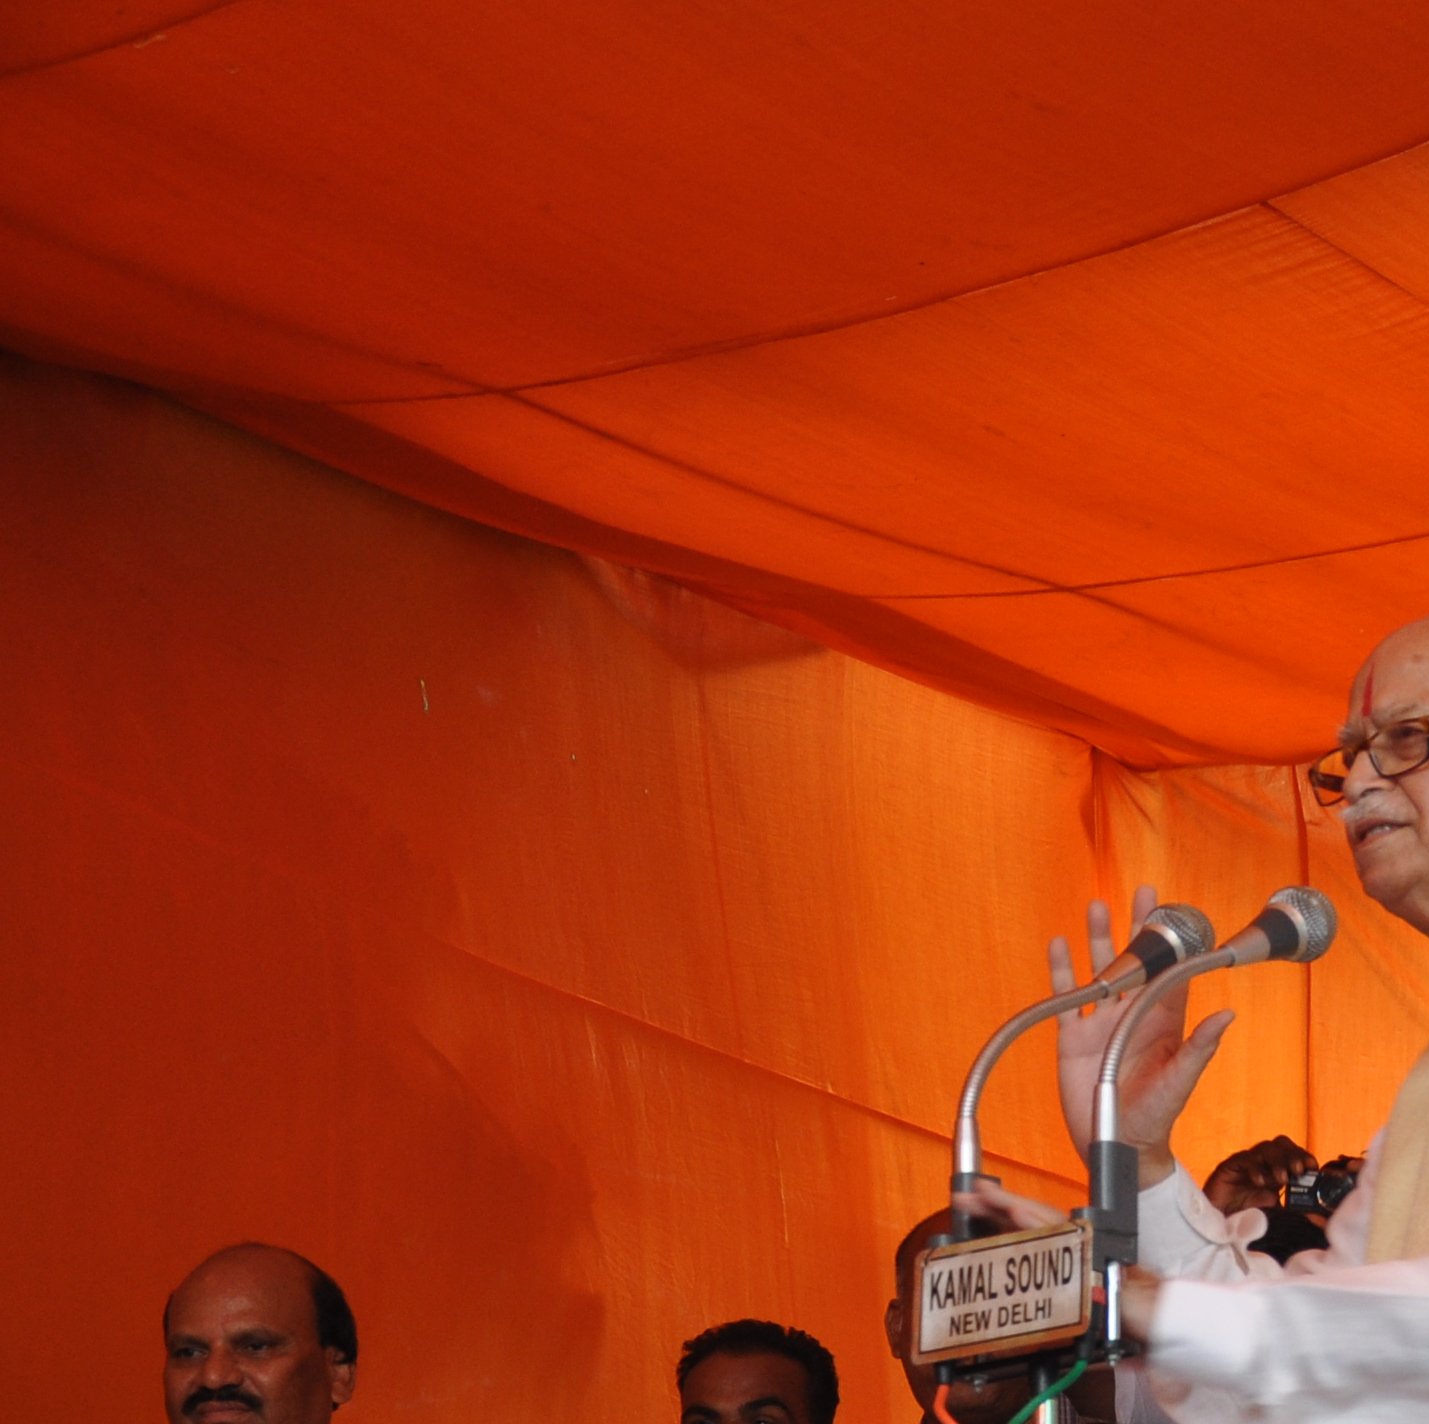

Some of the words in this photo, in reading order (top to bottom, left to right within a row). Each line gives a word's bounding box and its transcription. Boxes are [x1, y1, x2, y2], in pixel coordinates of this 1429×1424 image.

[929, 1261, 999, 1311] KAMAL
[1004, 1246, 1073, 1296] SOUND
[949, 1308, 993, 1337] NEW
[996, 1297, 1053, 1329] DELHI
